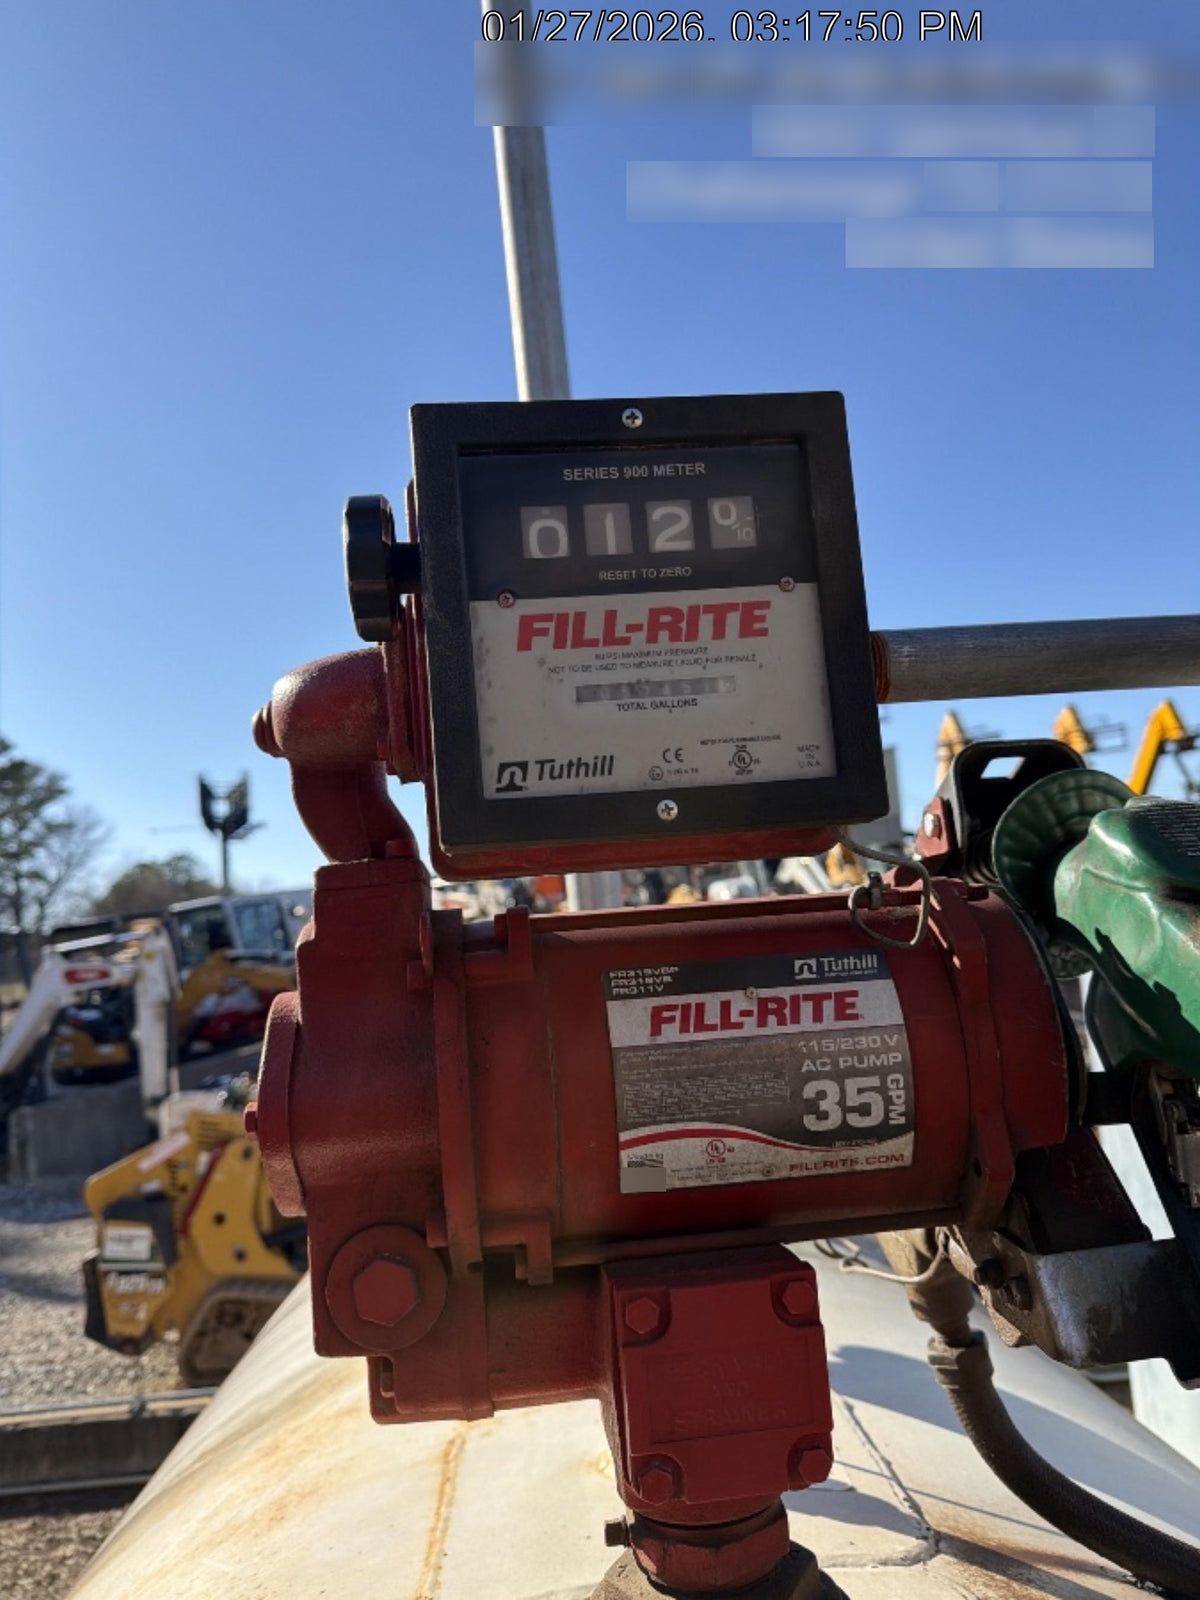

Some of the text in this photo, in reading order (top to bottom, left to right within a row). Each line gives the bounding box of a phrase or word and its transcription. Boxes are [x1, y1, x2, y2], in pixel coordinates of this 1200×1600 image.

[562, 462, 706, 481] SERIES 900 METER
[598, 566, 692, 581] RESET TO ZERO
[516, 600, 772, 652] FILL-RITE
[616, 697, 698, 712] TOTAL GALLONS
[534, 754, 614, 782] Tuthill
[818, 953, 878, 972] Tuthill
[649, 990, 859, 1037] FILL-RITE
[883, 1033, 899, 1047] V
[801, 1052, 902, 1073] AC PUMP
[802, 1075, 885, 1132] 35
[886, 1072, 907, 1125] GPM
[789, 1153, 905, 1172] FILLRITE.COM
